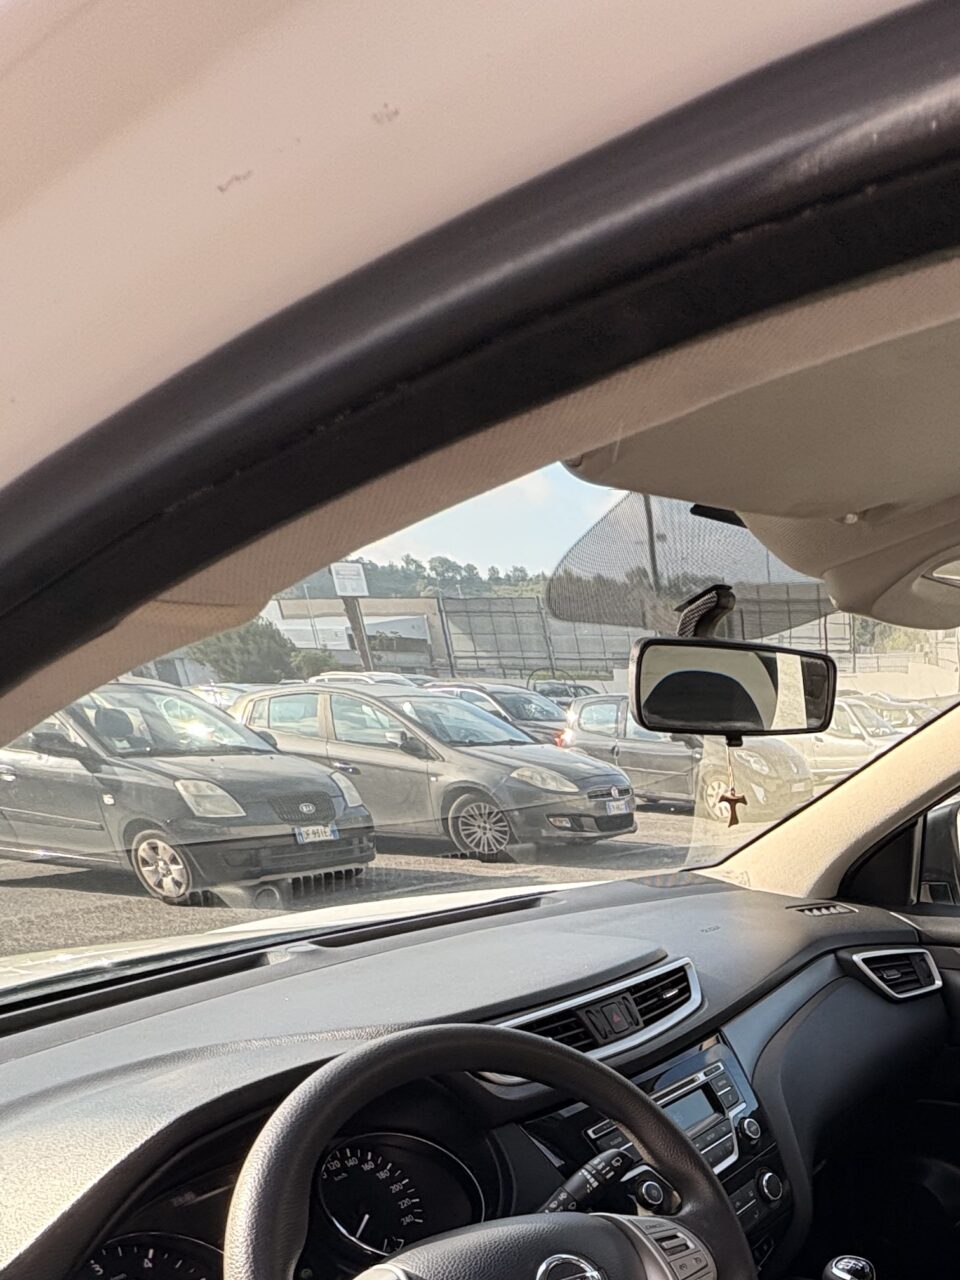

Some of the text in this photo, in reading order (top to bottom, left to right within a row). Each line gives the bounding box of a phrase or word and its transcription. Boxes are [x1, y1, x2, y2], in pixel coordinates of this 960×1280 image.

[327, 1160, 341, 1170] 120
[345, 1157, 359, 1167] 140
[361, 1161, 375, 1171] 160
[376, 1169, 390, 1180] 180
[390, 1182, 404, 1193] 200
[398, 1198, 412, 1209] 220
[401, 1214, 414, 1226] 240
[143, 1258, 153, 1268] 4
[92, 1263, 104, 1276] 3
